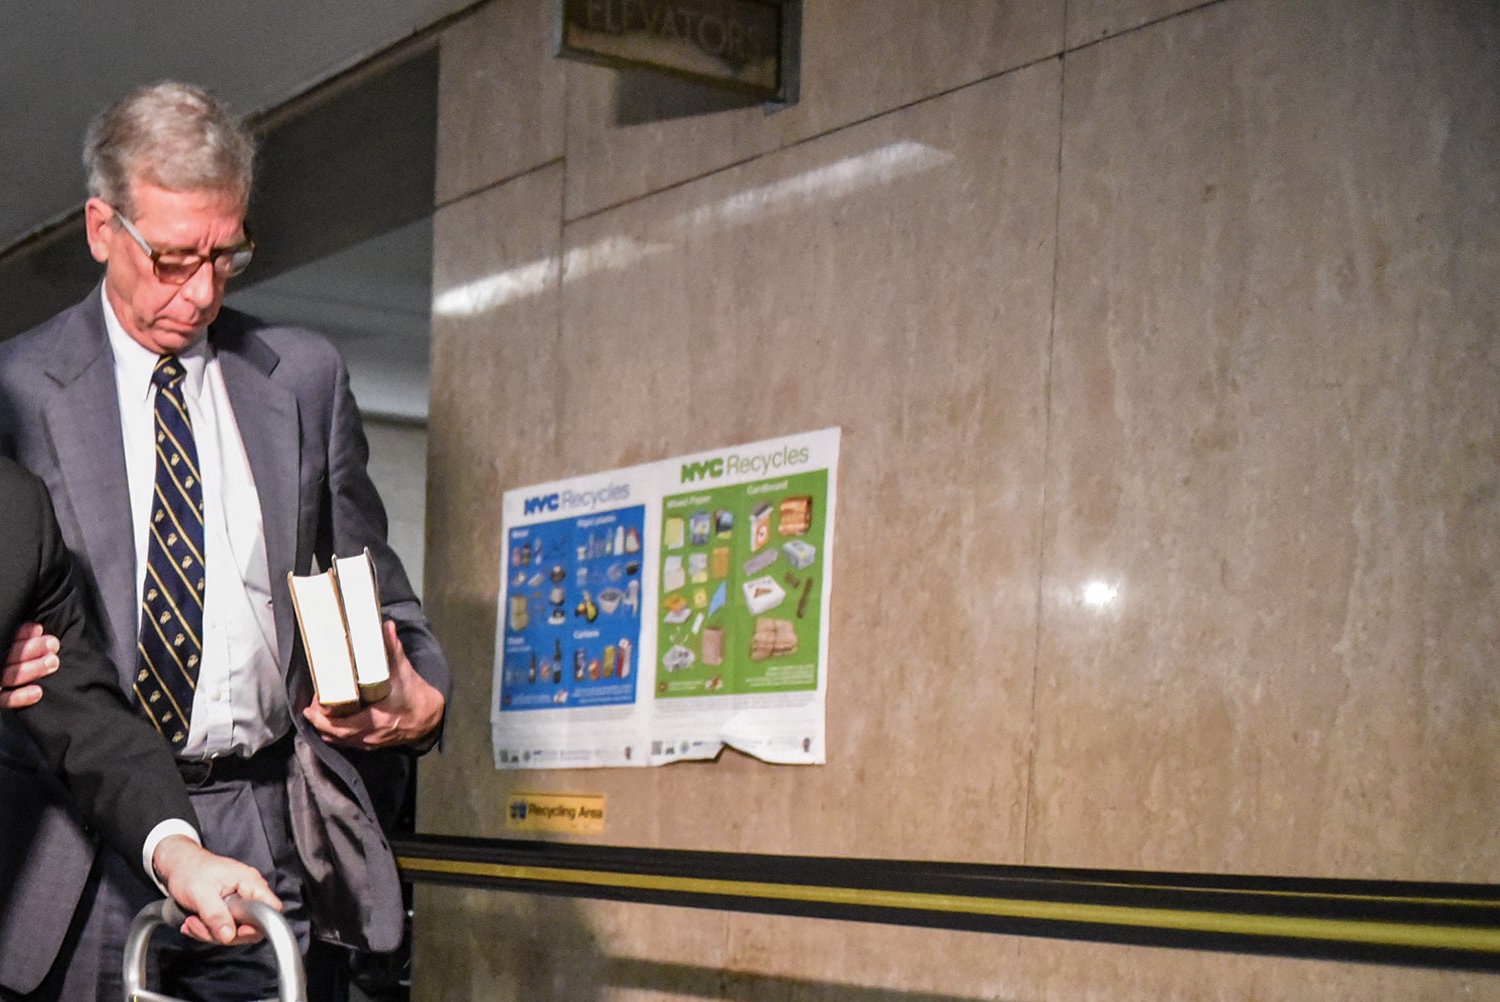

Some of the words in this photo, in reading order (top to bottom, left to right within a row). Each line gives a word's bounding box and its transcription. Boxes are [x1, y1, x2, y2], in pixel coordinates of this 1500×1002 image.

[680, 457, 724, 484] NYC
[726, 445, 809, 475] Recycles
[524, 493, 559, 516] NYC
[562, 482, 630, 509] Recycles
[528, 802, 576, 820] Recycling
[578, 806, 603, 819] Area
